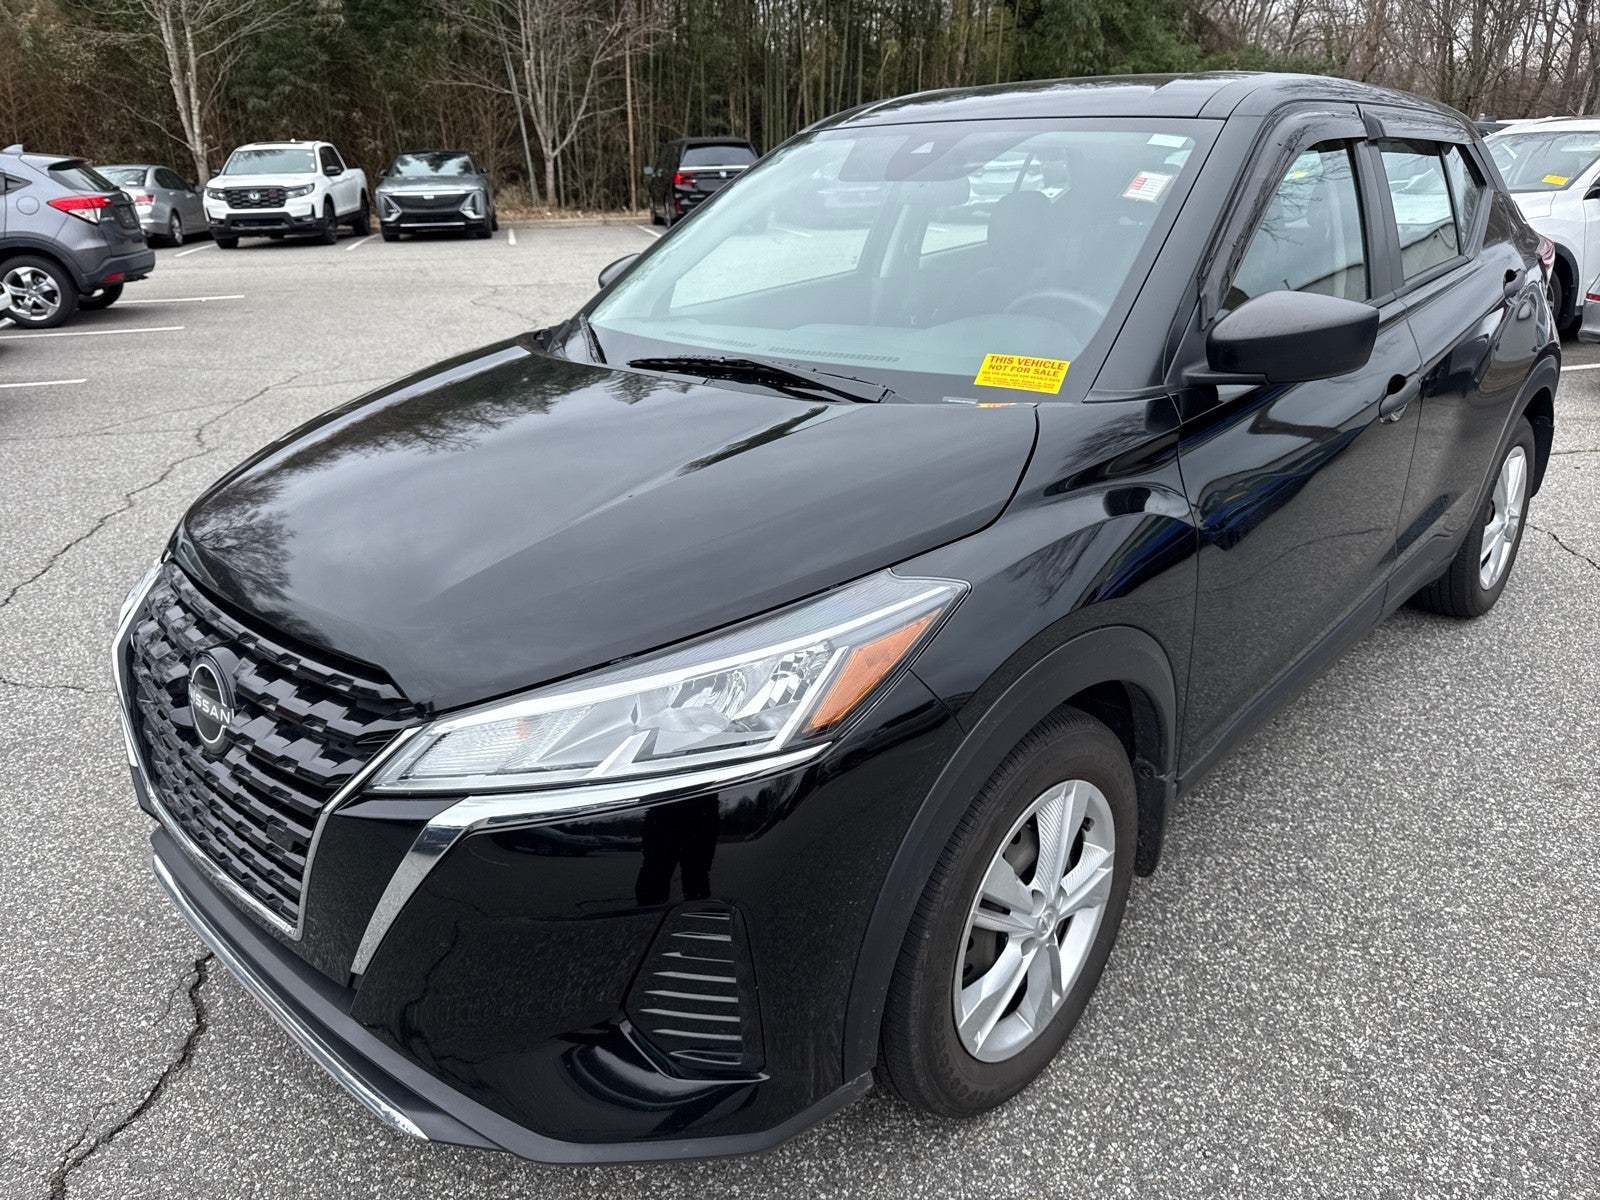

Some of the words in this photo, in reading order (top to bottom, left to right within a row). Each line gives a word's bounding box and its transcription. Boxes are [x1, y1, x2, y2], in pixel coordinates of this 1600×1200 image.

[990, 356, 1014, 364] THIS
[1018, 358, 1065, 370] VEHICLE
[988, 364, 1008, 372] NOT
[1033, 369, 1060, 377] SALE
[189, 686, 230, 724] NISSAN
